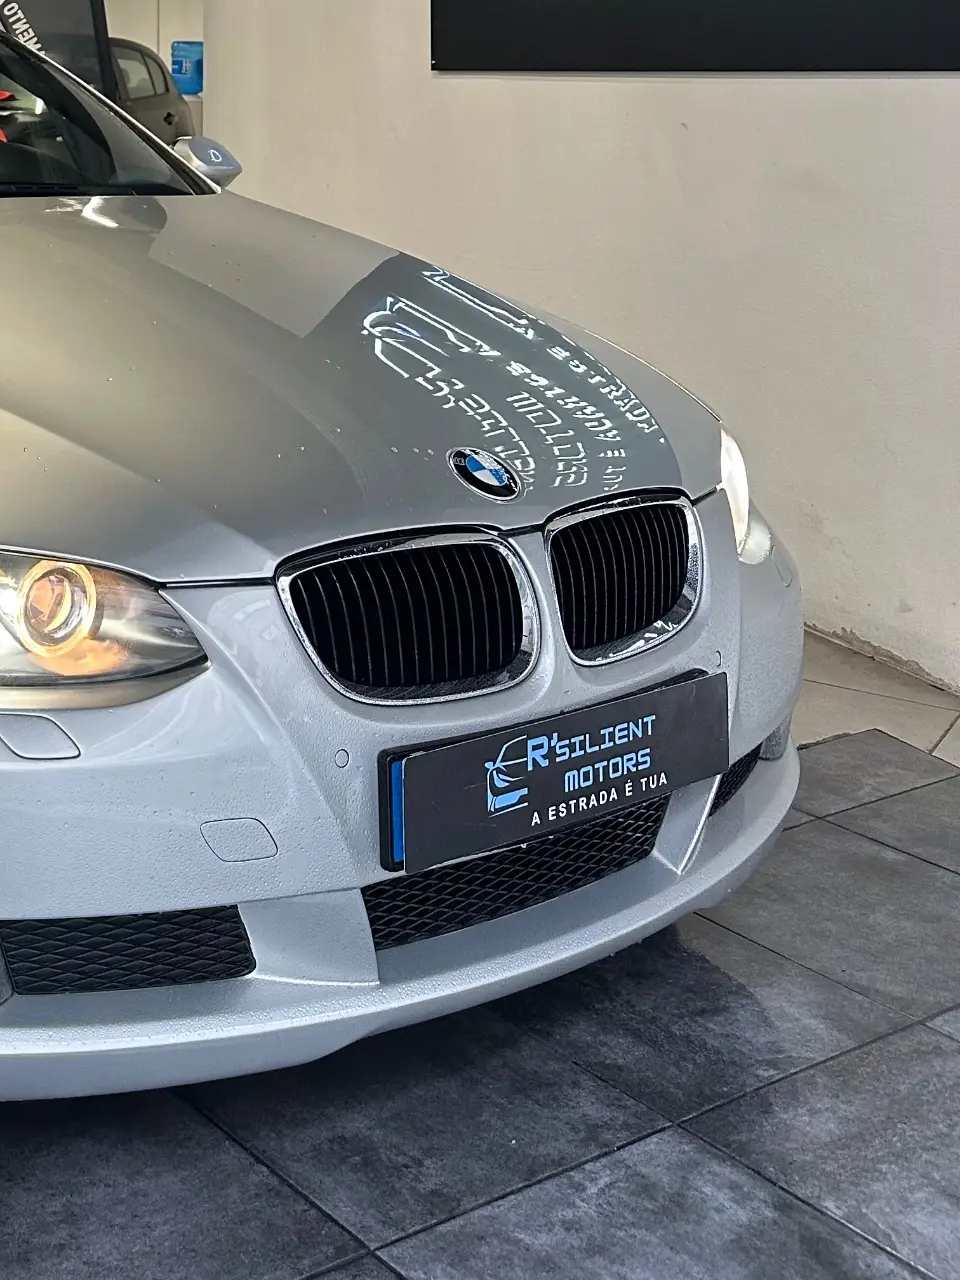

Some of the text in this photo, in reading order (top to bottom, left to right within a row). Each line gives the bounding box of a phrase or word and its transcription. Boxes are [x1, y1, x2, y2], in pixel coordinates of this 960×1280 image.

[527, 715, 656, 772] R'SILIENT
[564, 748, 651, 793] MOTORS
[531, 772, 668, 826] A ESTRADA É TUA
